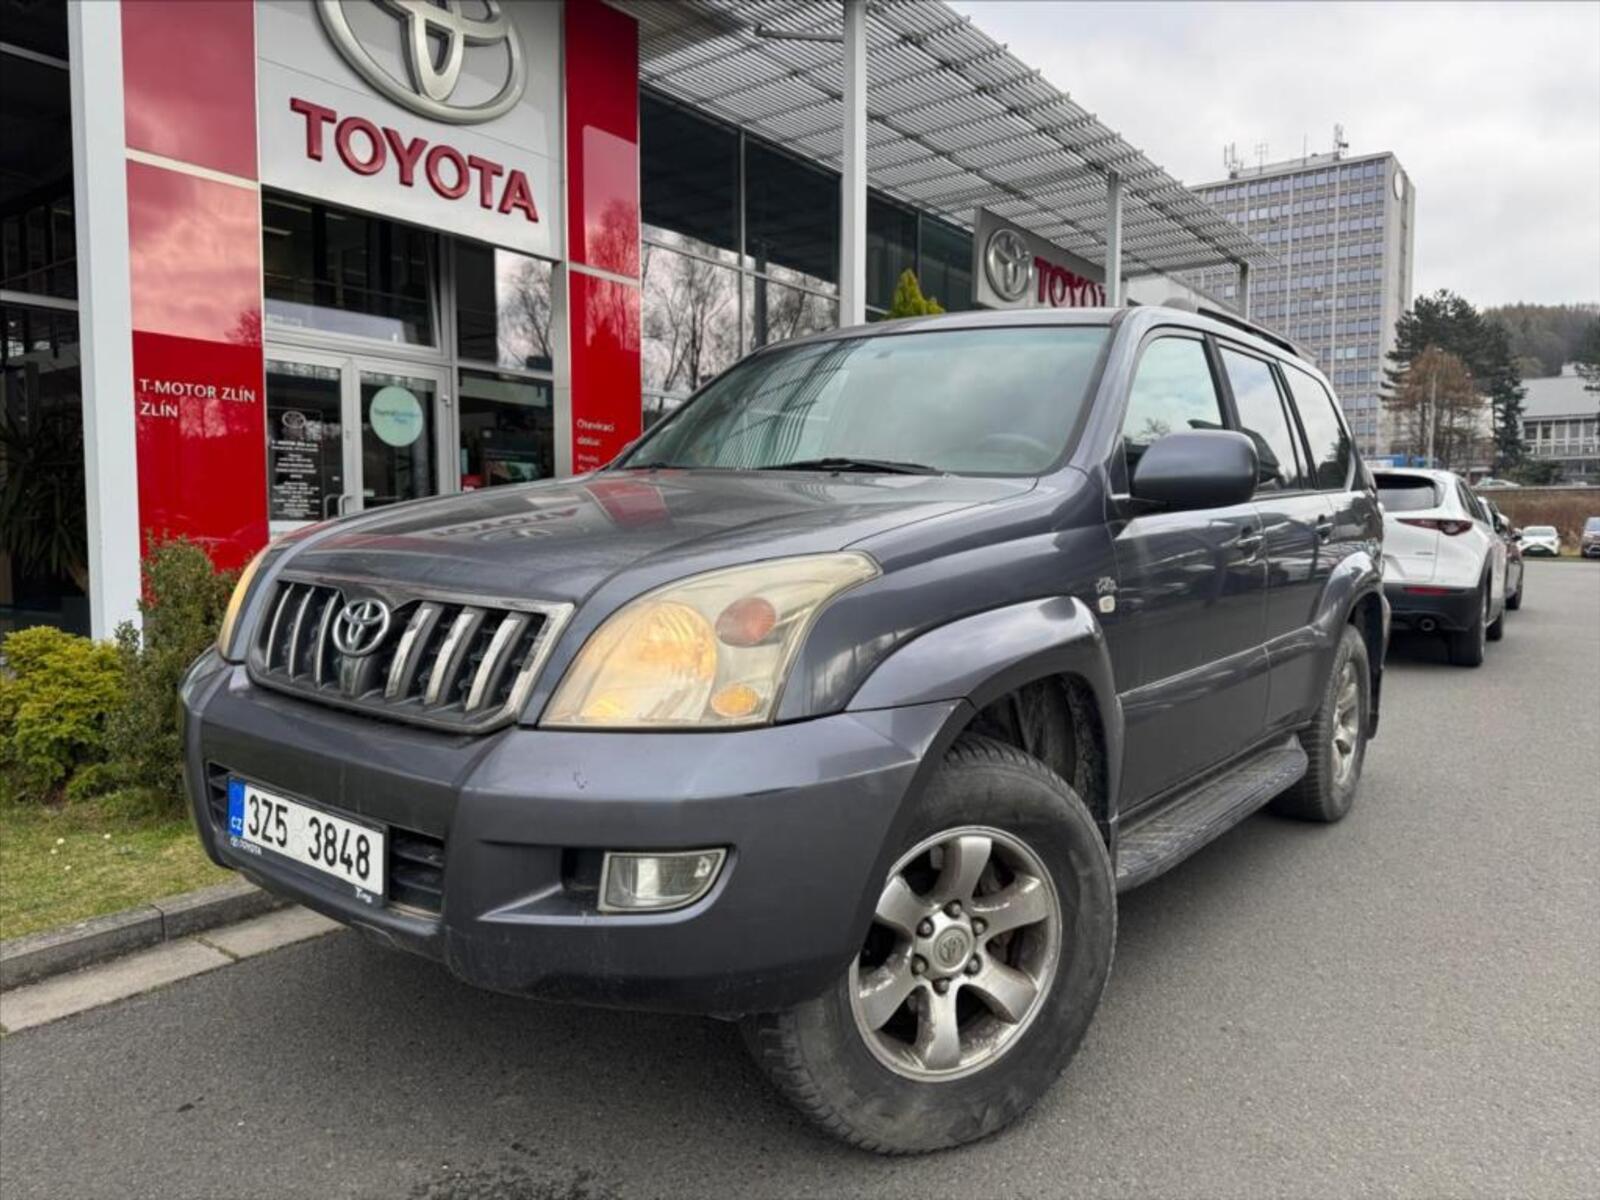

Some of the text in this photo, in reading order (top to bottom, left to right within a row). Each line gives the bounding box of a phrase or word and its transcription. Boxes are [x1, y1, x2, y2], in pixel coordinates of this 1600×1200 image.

[290, 97, 539, 223] TOYOTA
[1034, 256, 1106, 307] TOYO
[139, 378, 256, 403] T-MOTOR ZLÍN
[140, 399, 178, 417] ZLÍN
[231, 816, 242, 831] CZ
[248, 794, 371, 880] 3Z5 3848
